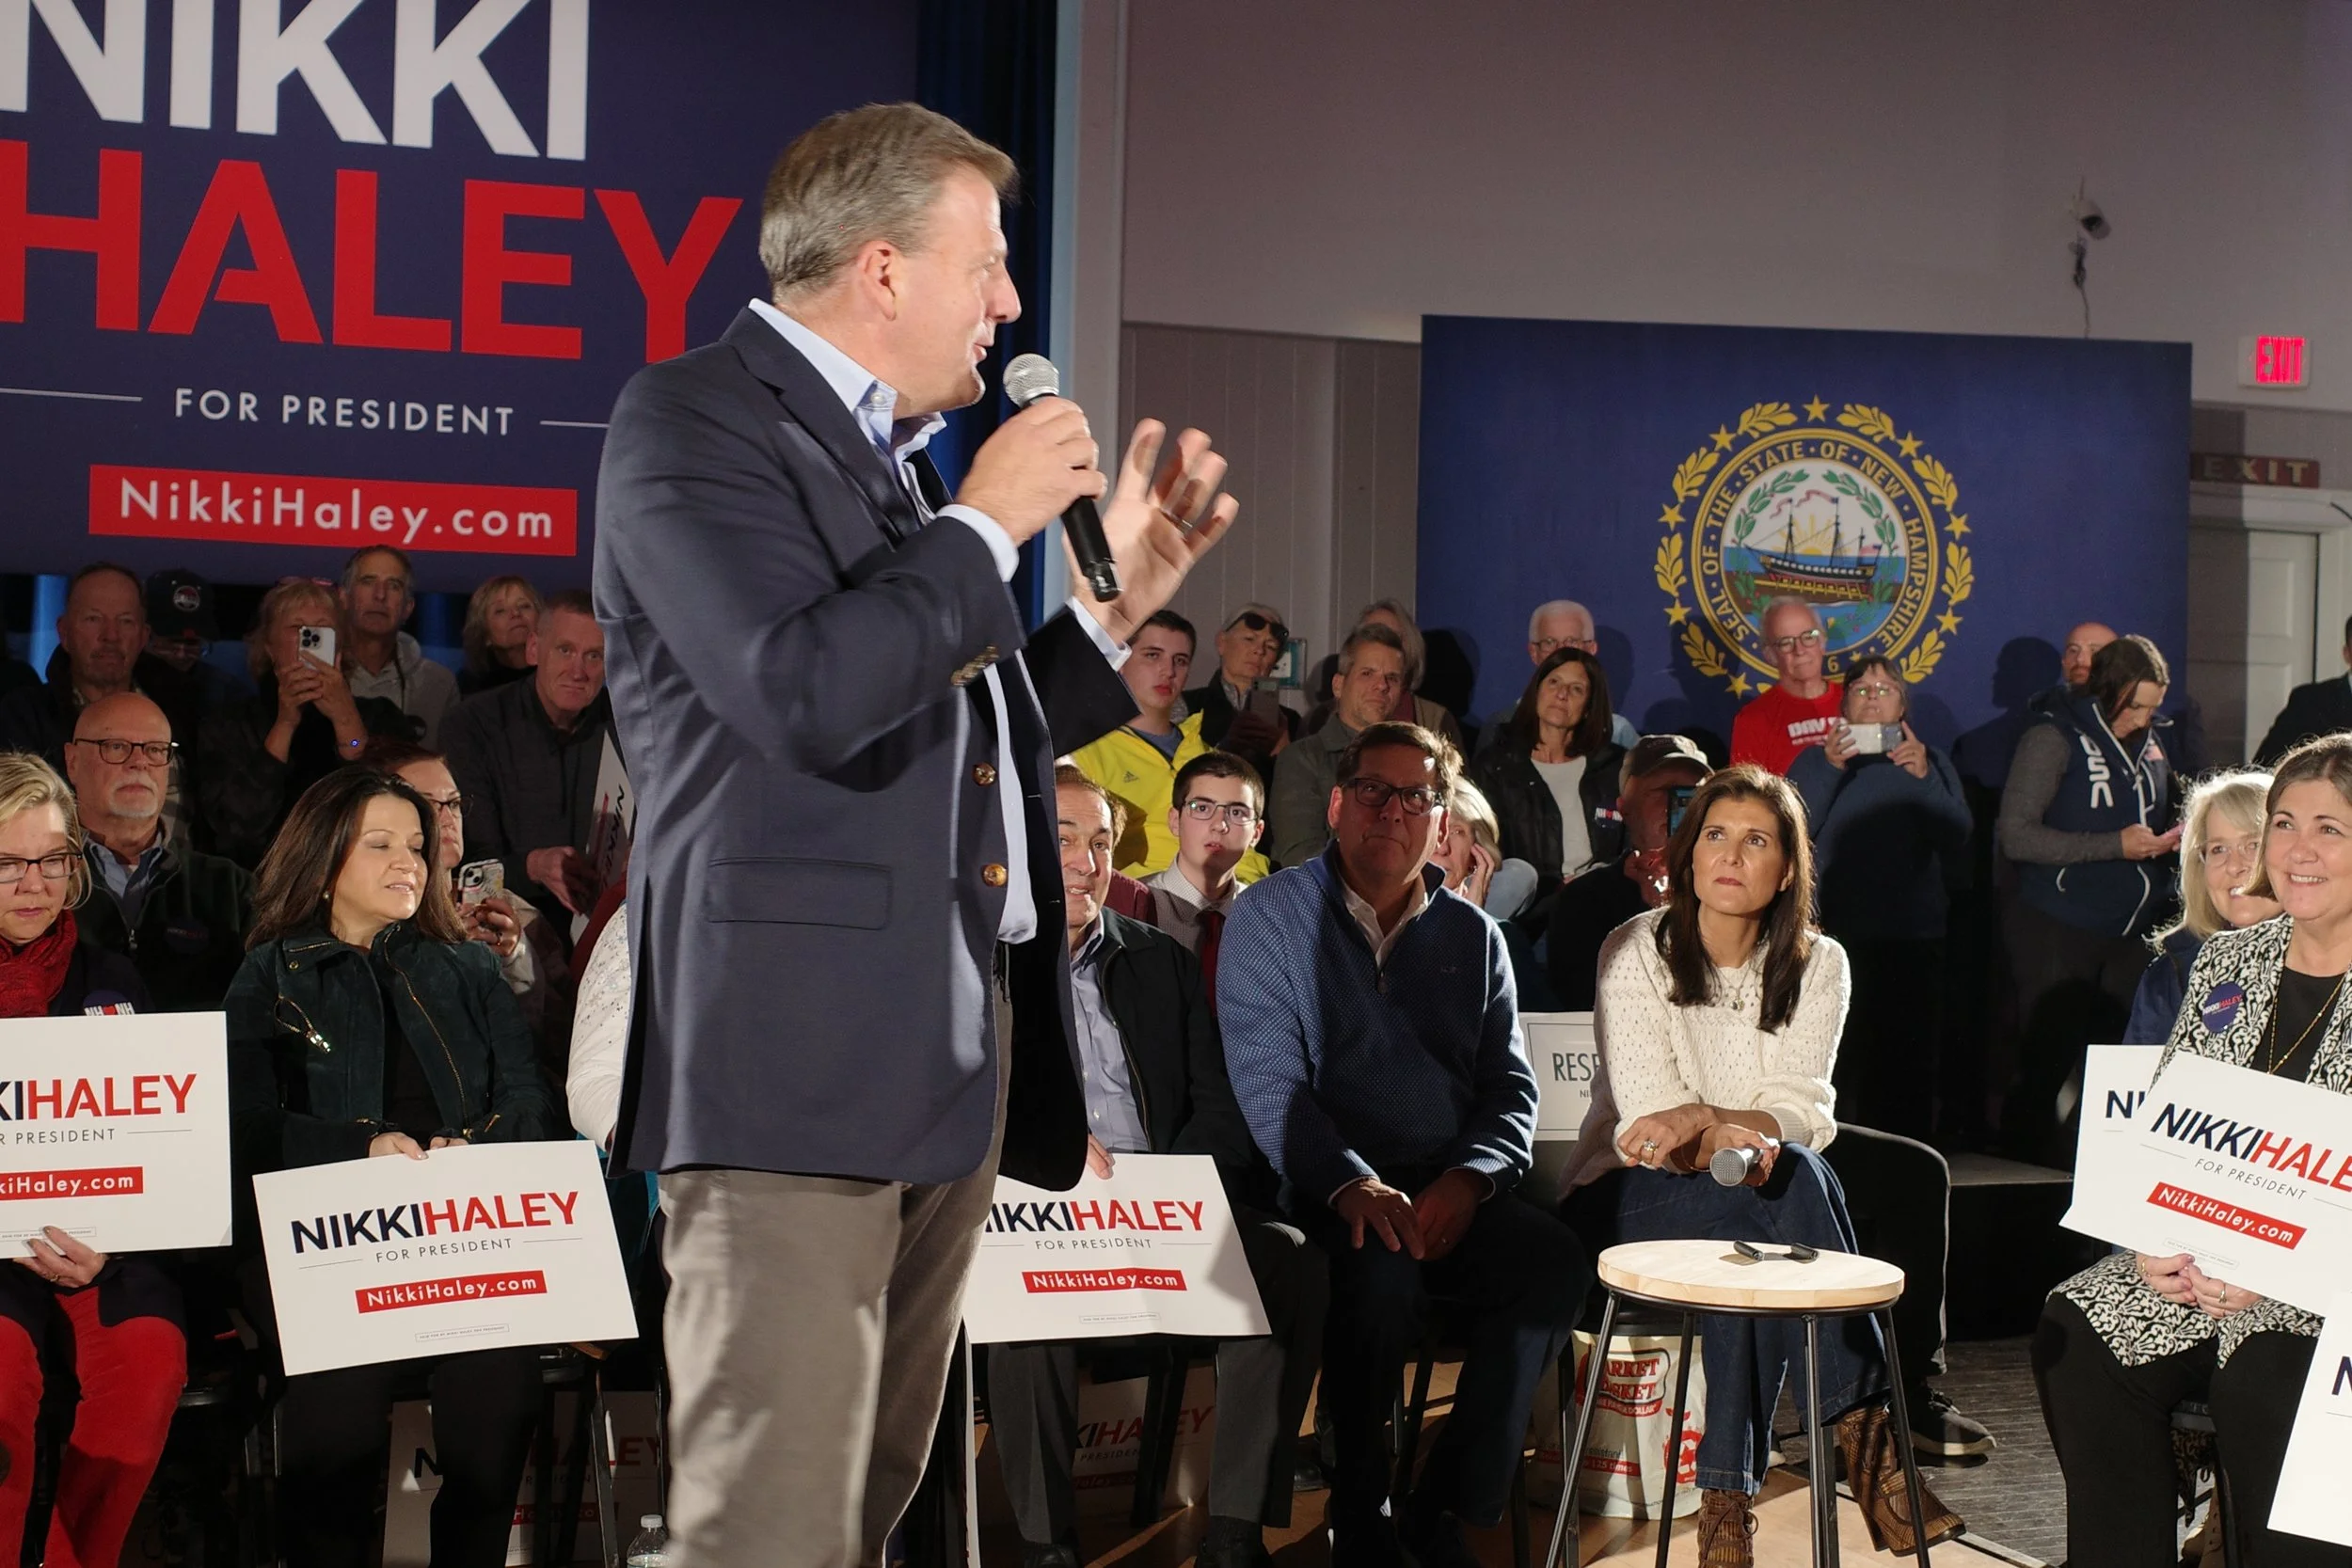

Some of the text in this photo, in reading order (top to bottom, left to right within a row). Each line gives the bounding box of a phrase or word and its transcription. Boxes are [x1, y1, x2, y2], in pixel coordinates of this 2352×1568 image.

[0, 0, 590, 161] NIKKI
[0, 140, 743, 363] HALEY
[2256, 335, 2305, 384] EXIT
[175, 388, 515, 436] FOR PRESIDENT
[2204, 458, 2308, 484] EXIT
[120, 478, 553, 545] NikkiHaley.com
[1702, 441, 1926, 647] SEAL OF THE STATE OF NEW HAMPSHIRE
[16, 1129, 116, 1145] PRESIDENT
[2150, 1102, 2352, 1193] NIKKIHALE
[2195, 1158, 2308, 1200] FOR PRESIDENT
[291, 1191, 579, 1254] NIKKIHALEY
[985, 1199, 1203, 1233] IKKIHALEY
[2158, 1187, 2295, 1243] NikkiHaley.com
[375, 1238, 513, 1263] FOR PRESIDENT
[1035, 1238, 1152, 1250] FOR PRESIDENT
[367, 1277, 537, 1307] NikkiHaley.com
[1032, 1272, 1178, 1289] NikkiHaley.com
